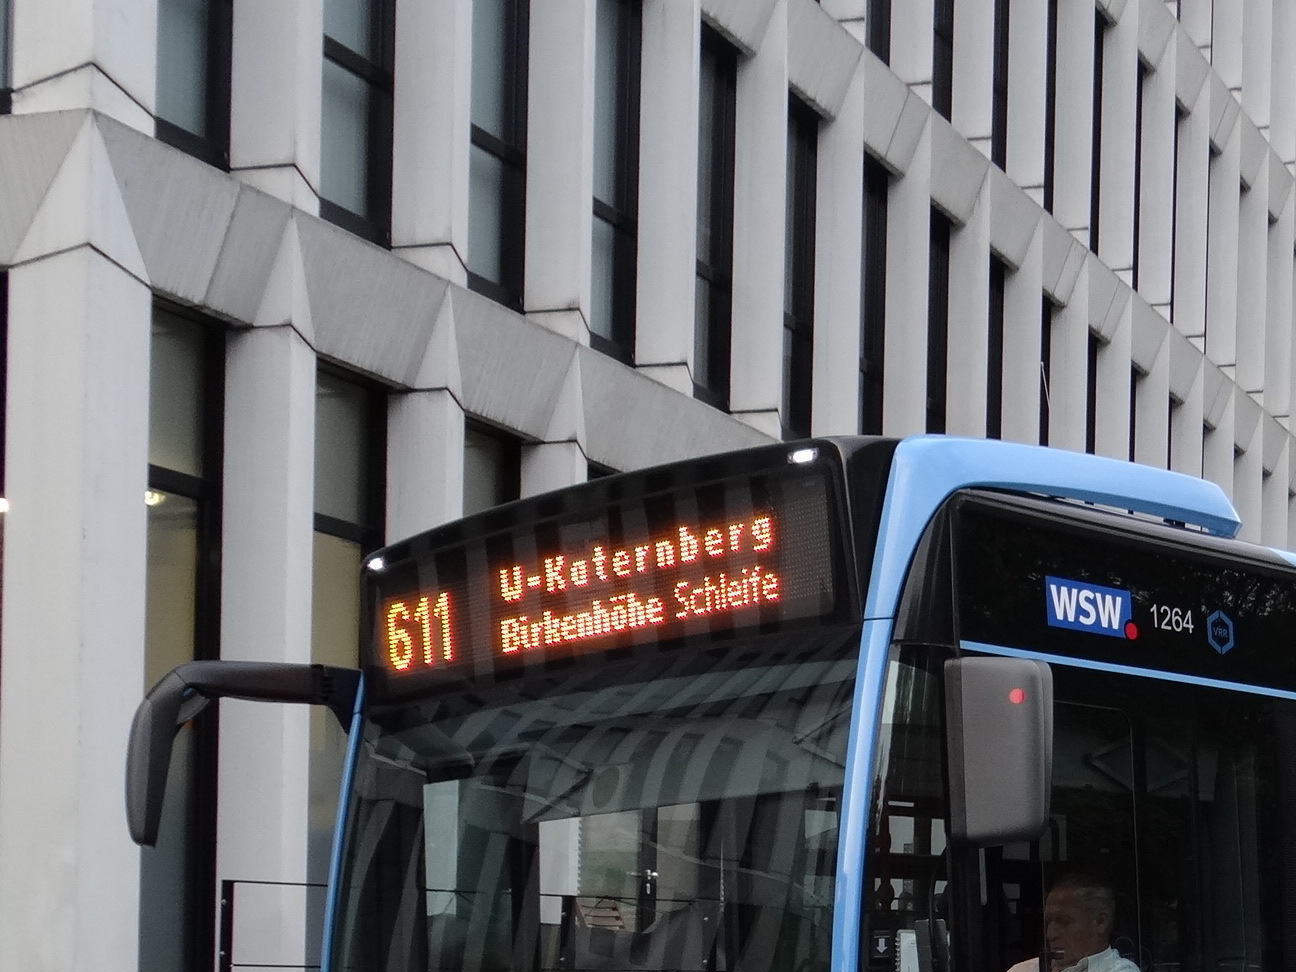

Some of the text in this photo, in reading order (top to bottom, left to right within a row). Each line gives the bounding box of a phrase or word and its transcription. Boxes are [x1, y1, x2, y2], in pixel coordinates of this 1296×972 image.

[500, 516, 774, 602] U-Katernberg
[387, 593, 453, 670] 611
[500, 565, 779, 653] Birkenhöhe Schleife
[1050, 584, 1122, 630] WSW
[1150, 604, 1194, 634] 1264
